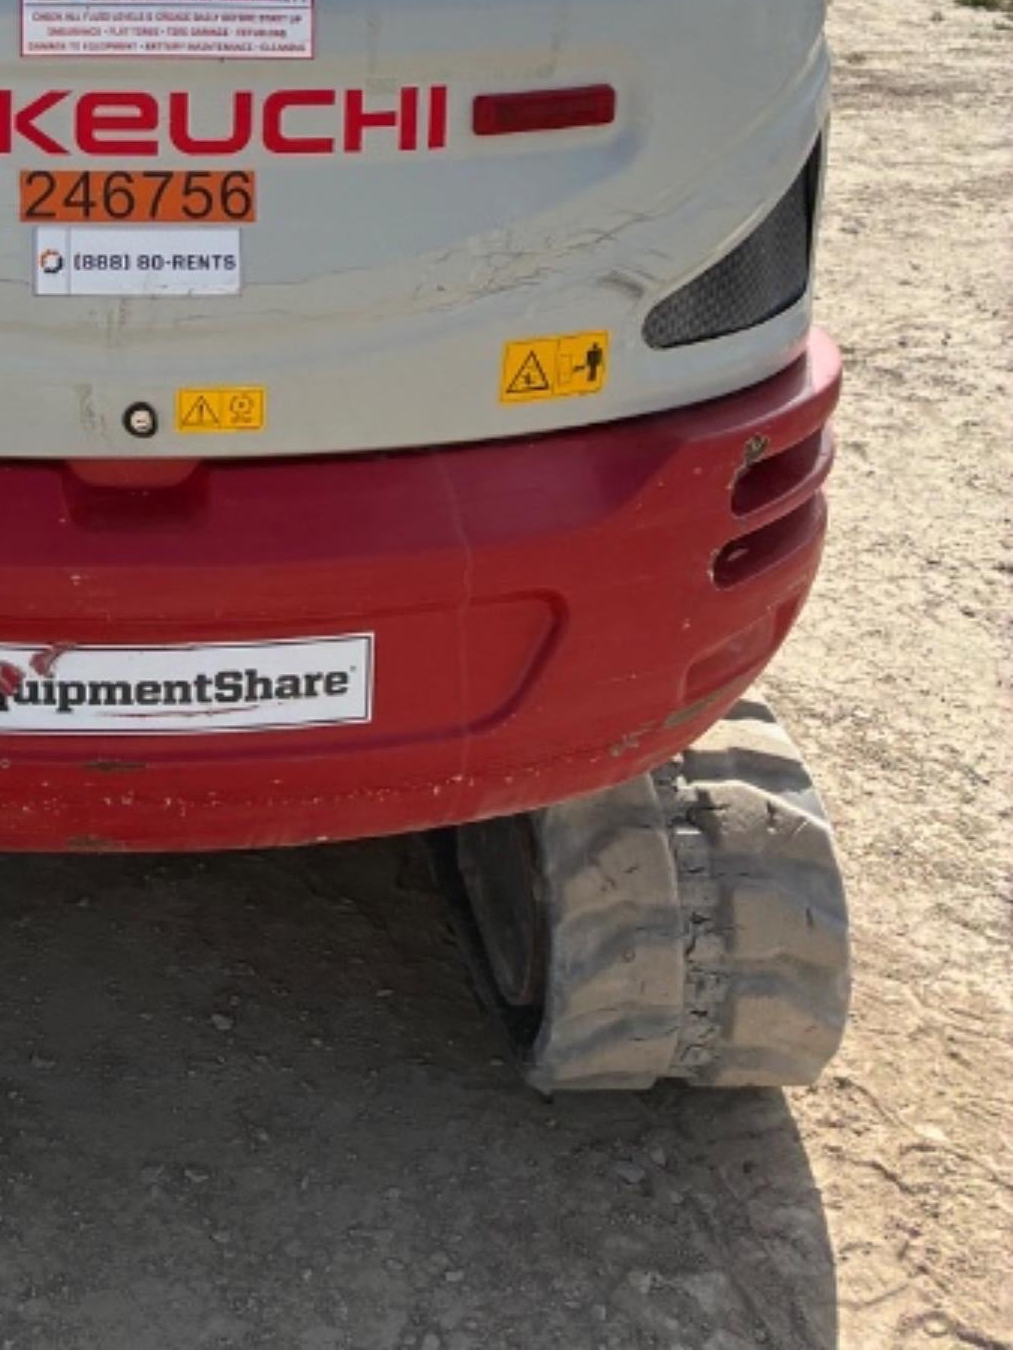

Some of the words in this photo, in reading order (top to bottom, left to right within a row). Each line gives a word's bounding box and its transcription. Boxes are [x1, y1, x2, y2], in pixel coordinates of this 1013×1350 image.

[25, 170, 252, 219] 246756
[73, 253, 130, 271] (888)
[136, 253, 237, 271] 80-RENTS
